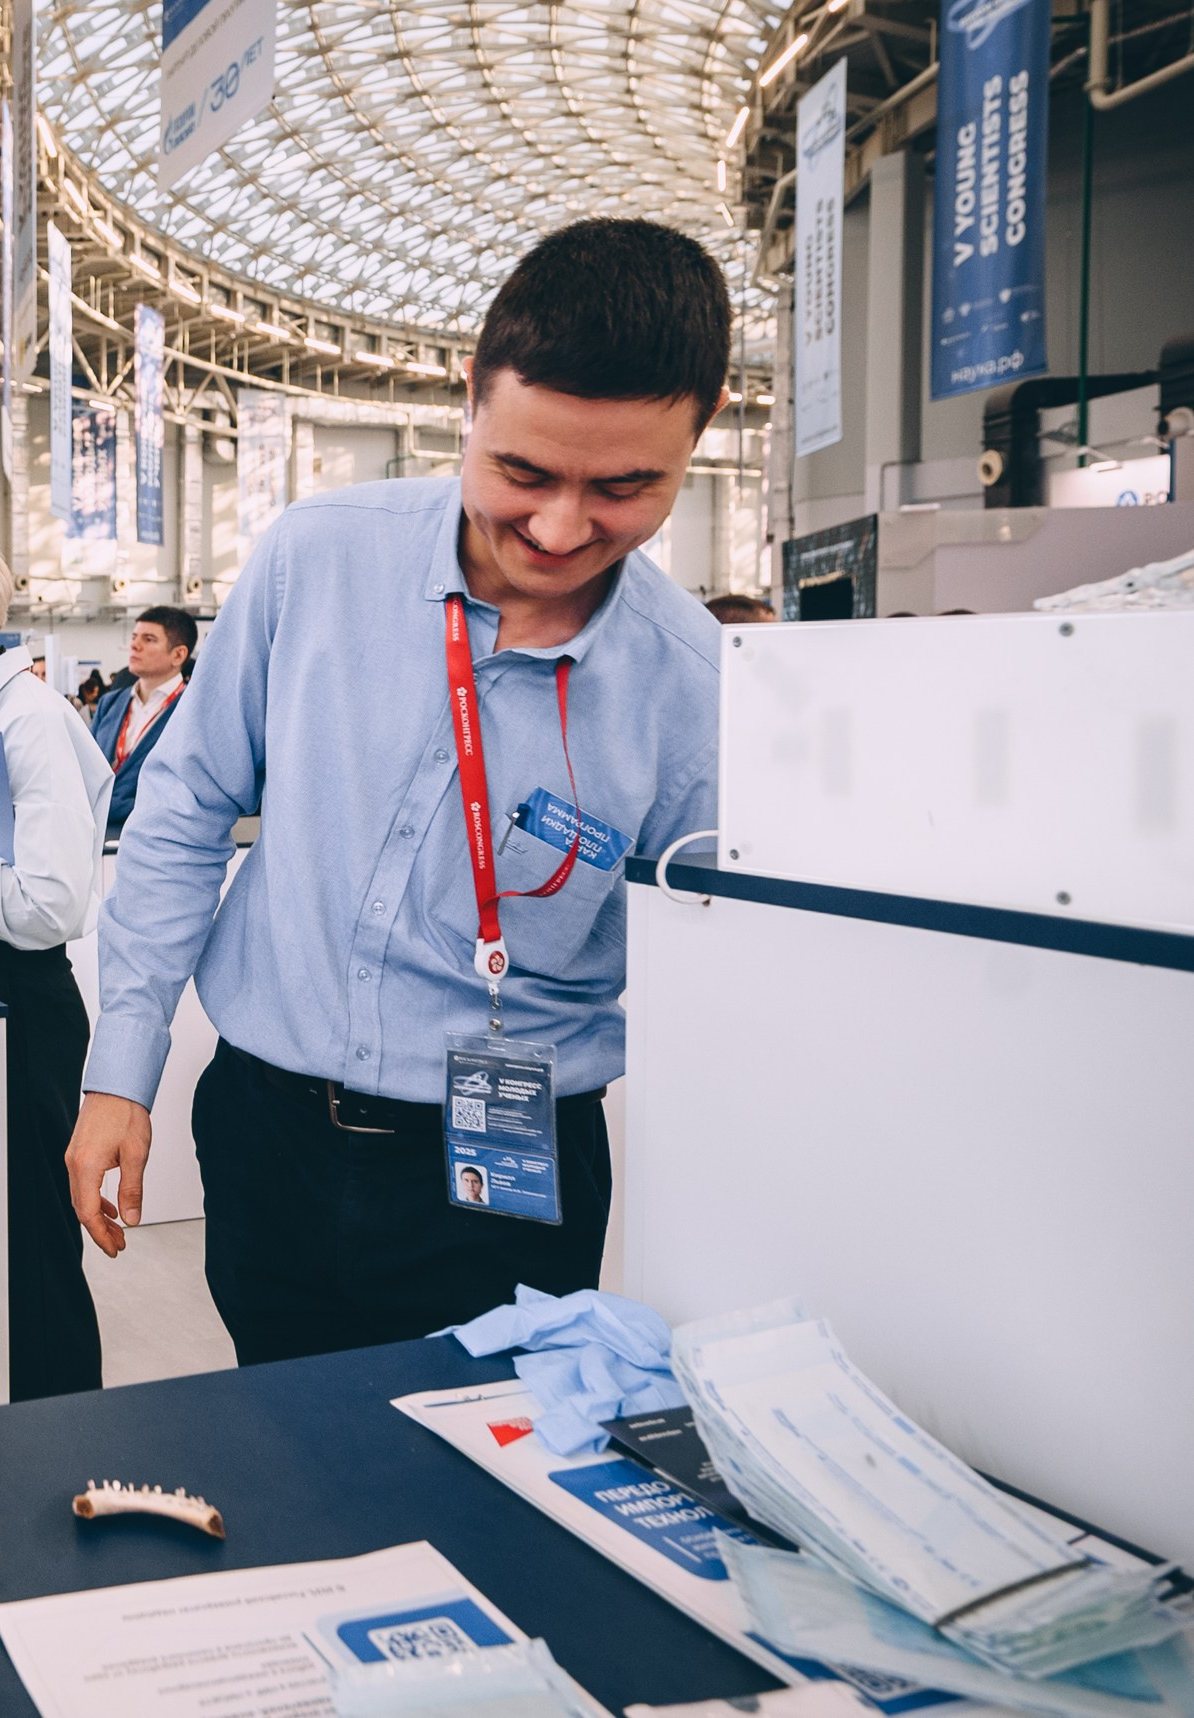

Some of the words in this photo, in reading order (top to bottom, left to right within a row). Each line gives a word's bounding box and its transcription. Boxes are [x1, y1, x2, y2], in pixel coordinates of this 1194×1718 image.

[979, 74, 1003, 257] SCIENTISTS
[1006, 69, 1030, 246] CONGRESS
[954, 121, 977, 238] YOUNG
[953, 242, 975, 268] V
[451, 599, 461, 642] CONGRESS
[547, 802, 611, 843] ПРОГРАММА
[564, 836, 598, 860] КАРА
[593, 1480, 671, 1504] ПЕРЕДО
[613, 1491, 696, 1517] ИМПОРТ
[633, 1506, 715, 1530] ТЕХНОЛ
